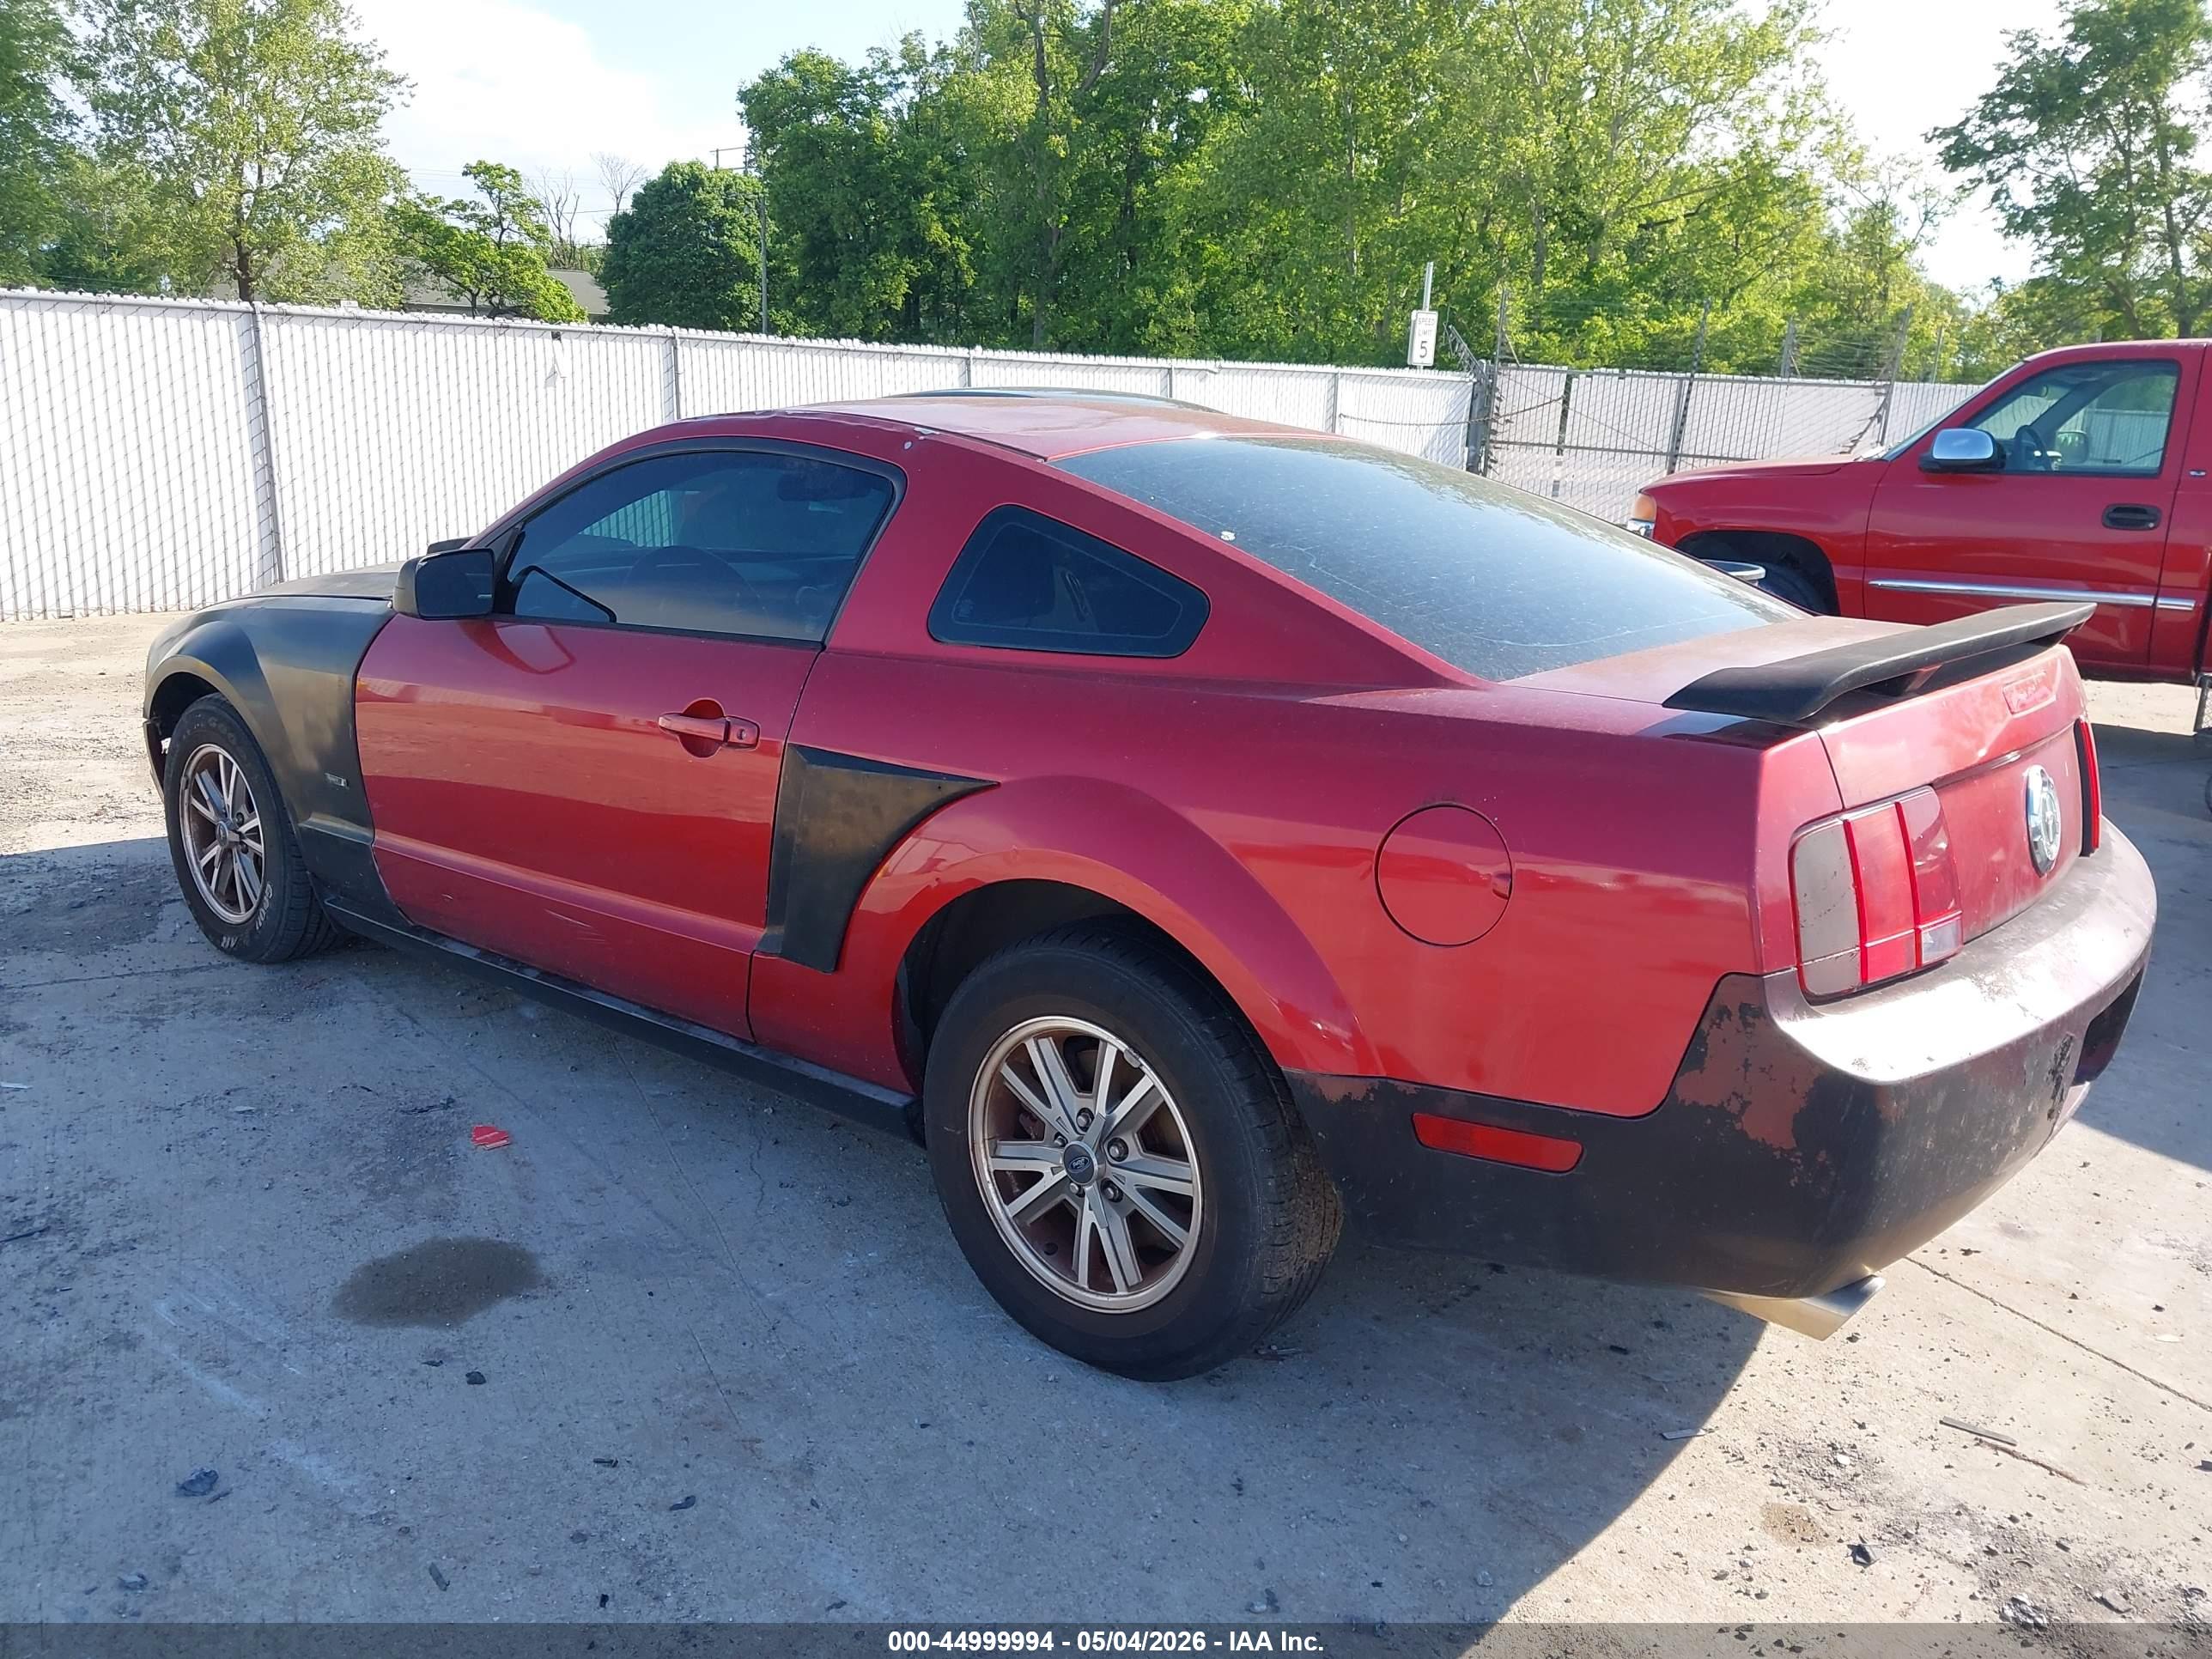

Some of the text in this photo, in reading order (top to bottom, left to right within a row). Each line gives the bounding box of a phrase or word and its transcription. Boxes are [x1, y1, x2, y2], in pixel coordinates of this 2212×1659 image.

[1419, 317, 1435, 325] SPEED
[1418, 329, 1432, 337] LIMIT
[1419, 340, 1428, 358] 5
